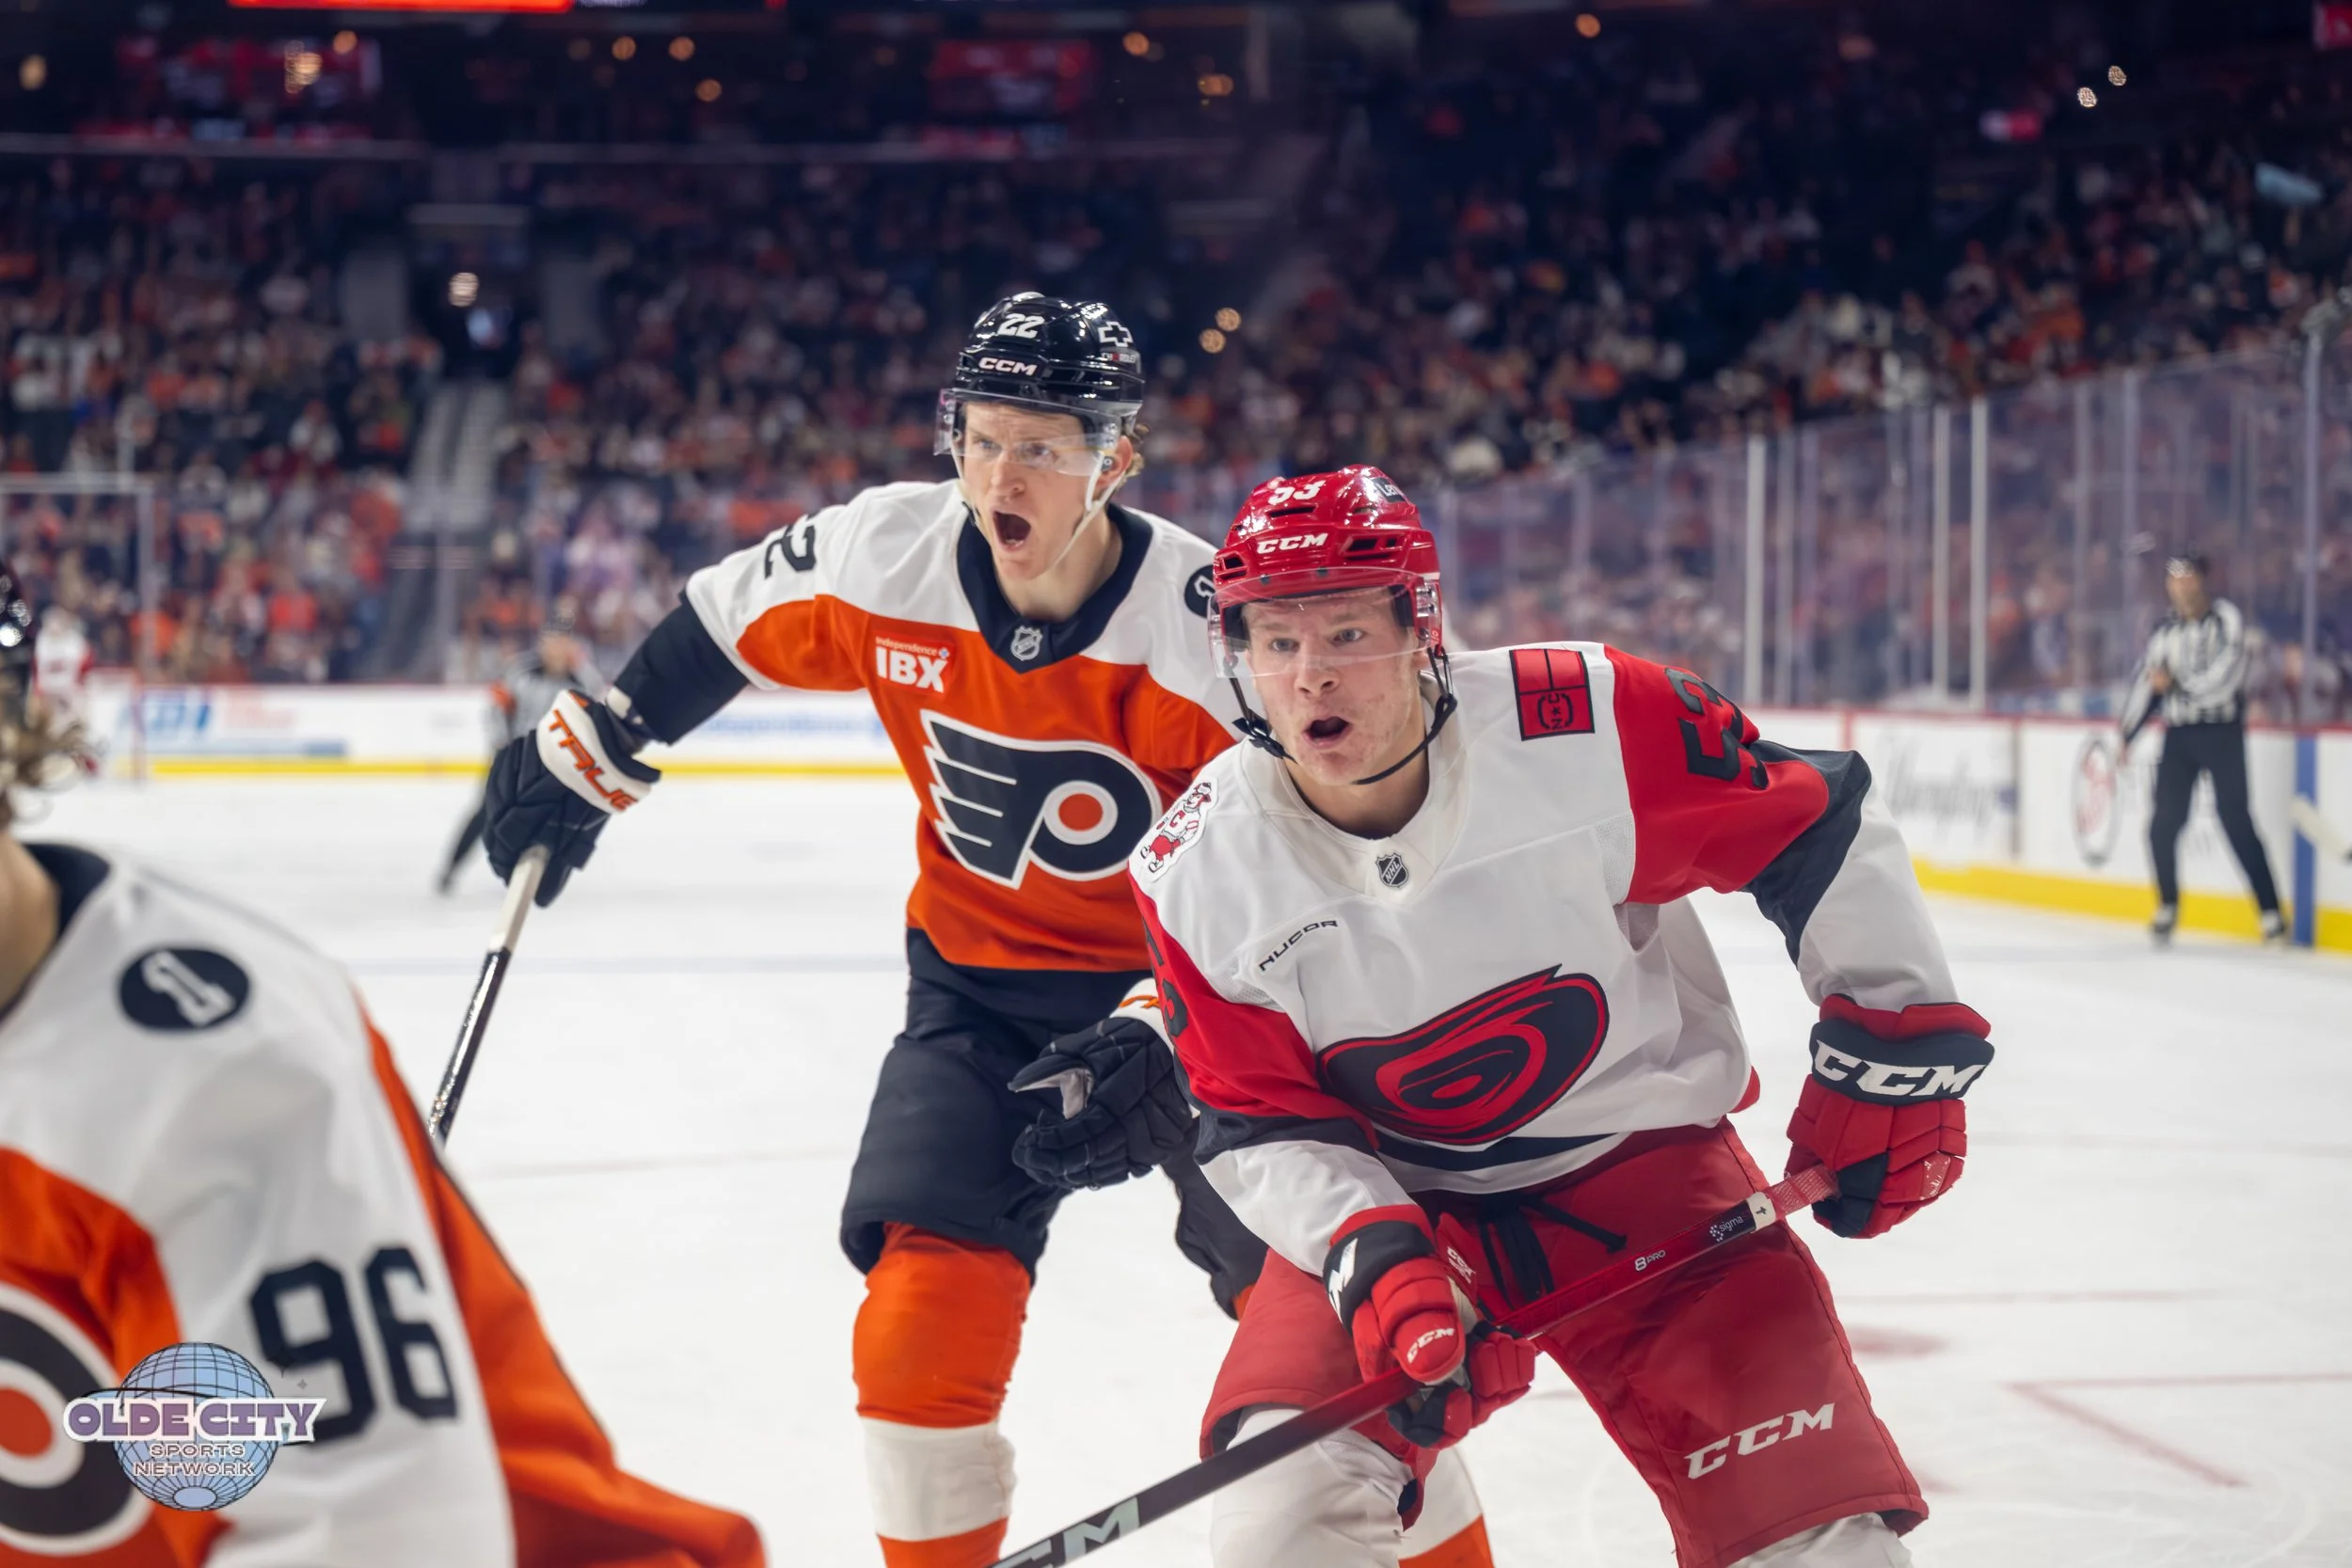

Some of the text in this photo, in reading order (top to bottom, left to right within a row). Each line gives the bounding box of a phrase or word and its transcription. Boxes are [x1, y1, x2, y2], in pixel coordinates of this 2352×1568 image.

[997, 312, 1044, 339] 22
[978, 356, 1037, 376] CCM
[1256, 532, 1329, 555] CCM
[875, 646, 948, 693] IBX
[548, 709, 640, 813] TRUE
[1385, 861, 1400, 882] NHL
[1258, 920, 1339, 972] NUCOR
[1814, 1038, 1987, 1097] CCM
[1719, 1215, 1744, 1232] sigma
[247, 1246, 459, 1447] 96
[1406, 1326, 1455, 1364] CCM
[1683, 1402, 1836, 1481] CCM
